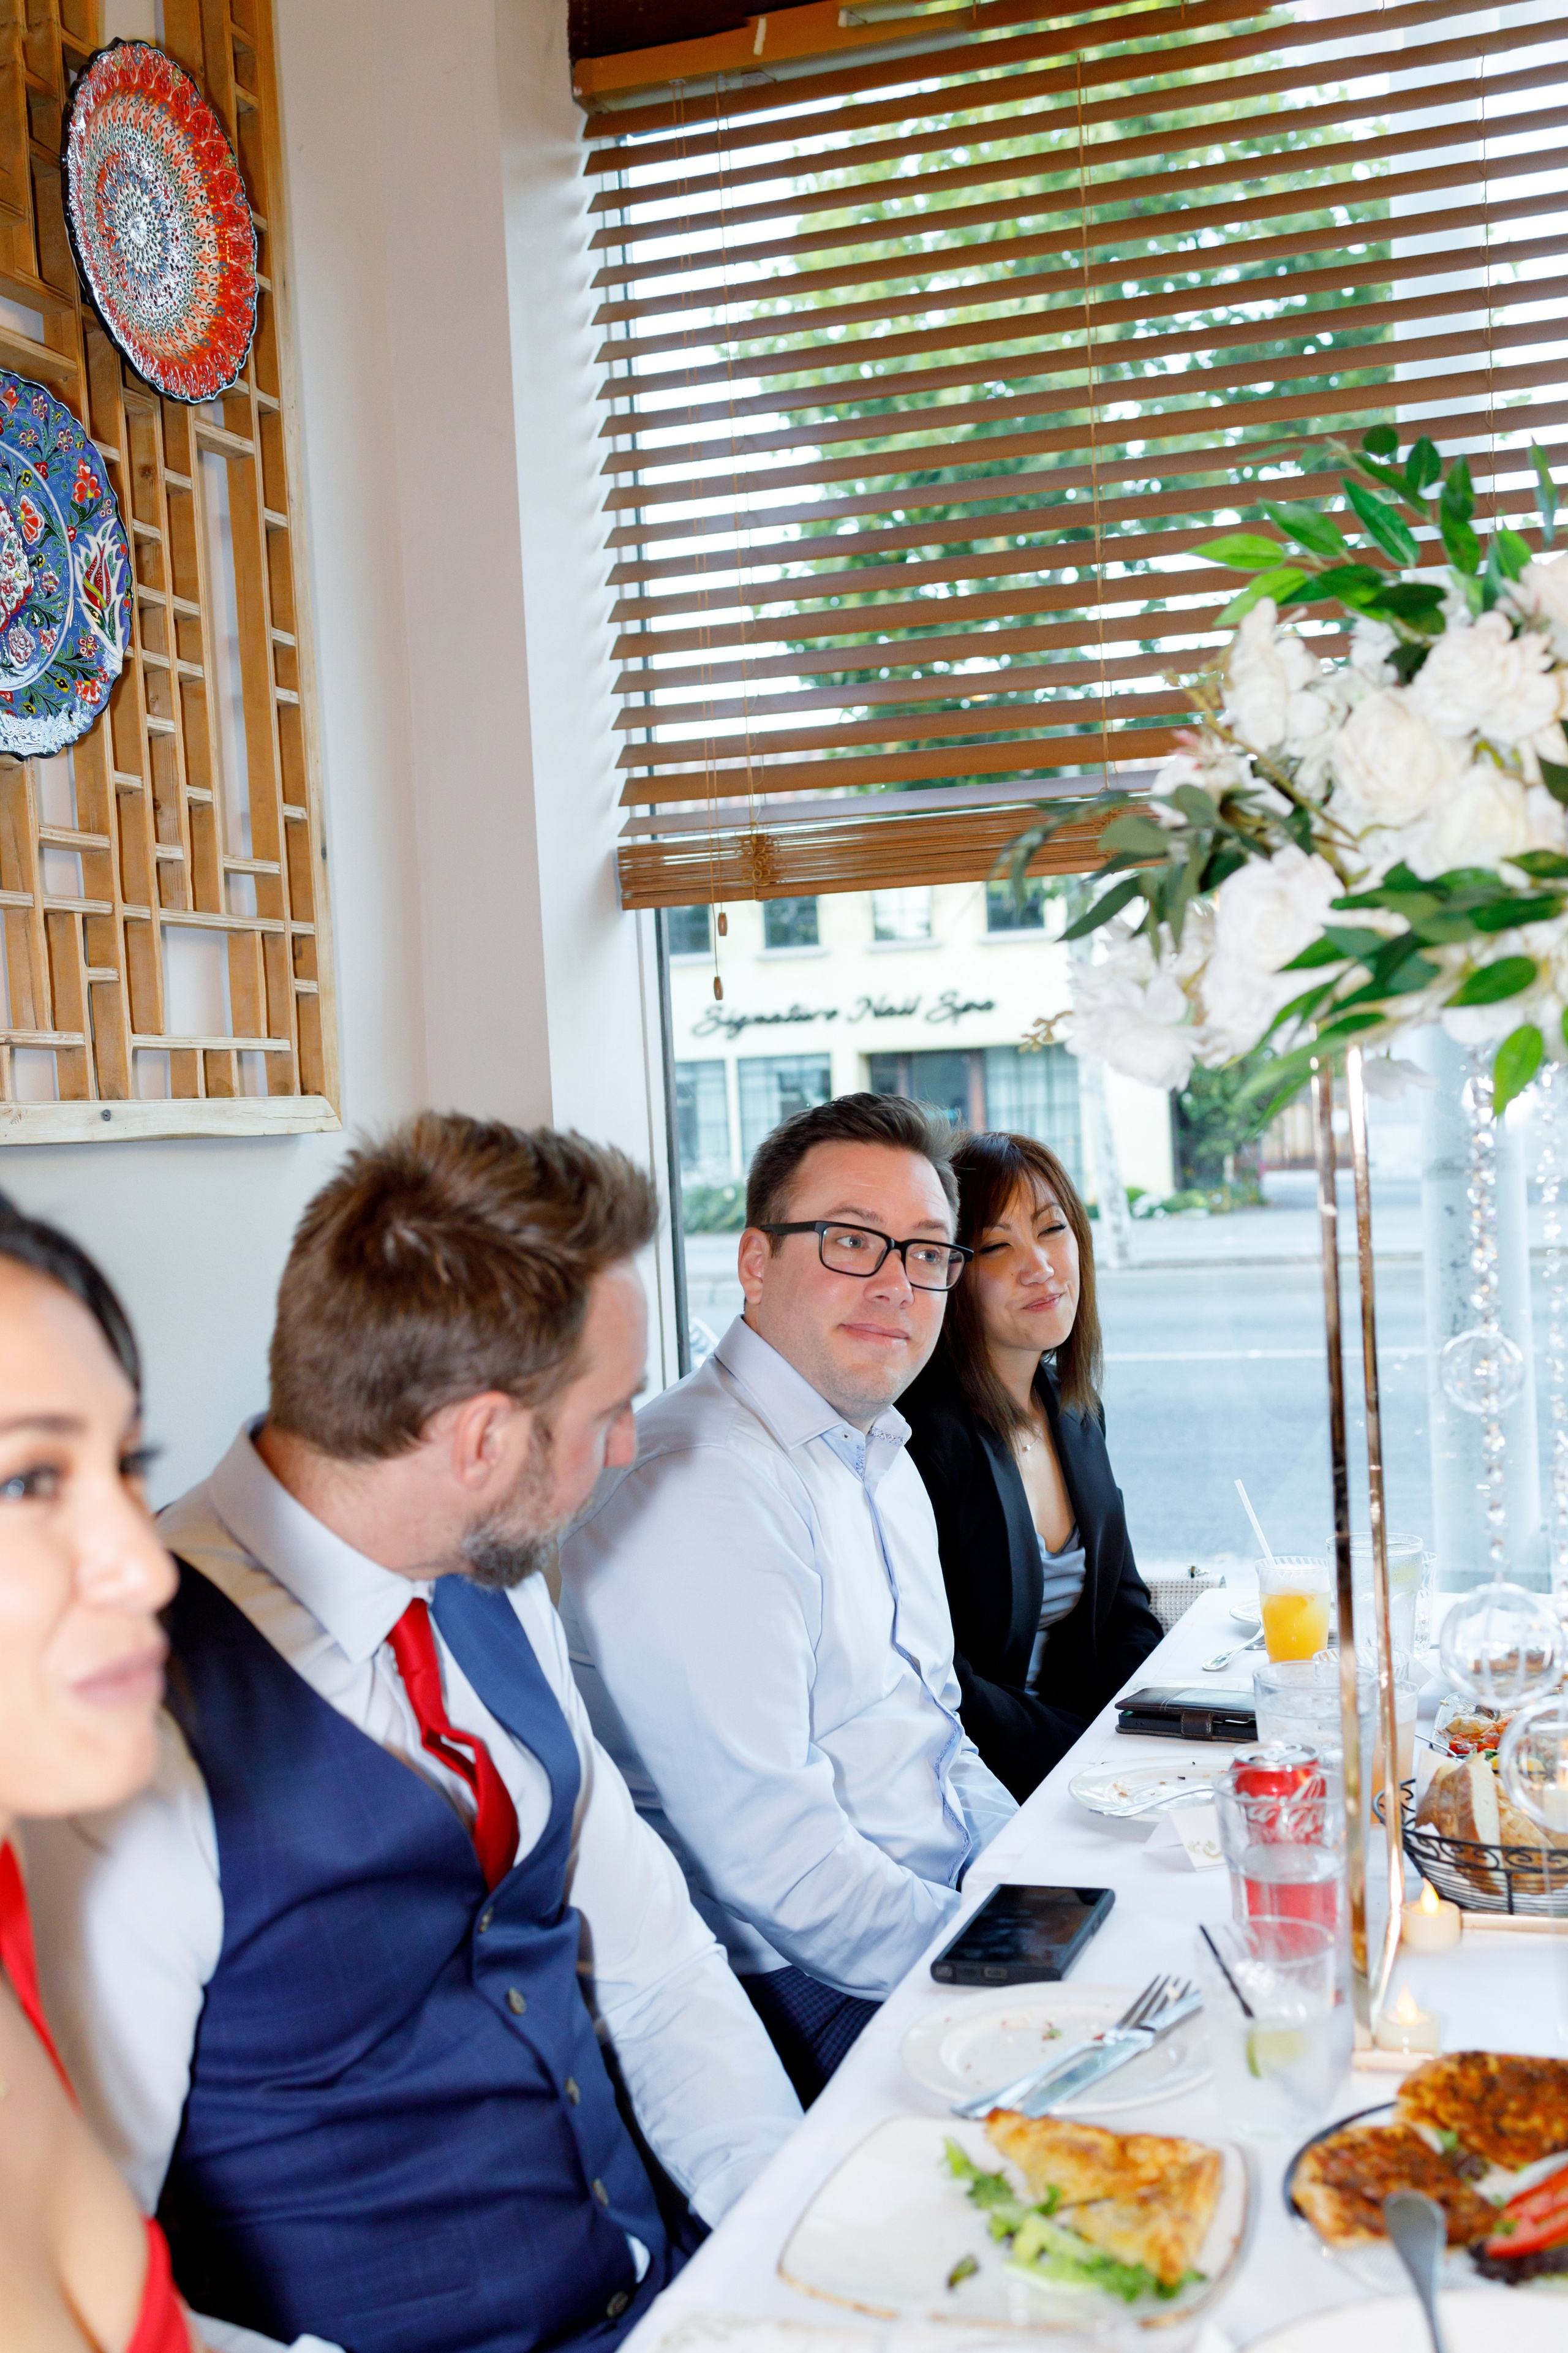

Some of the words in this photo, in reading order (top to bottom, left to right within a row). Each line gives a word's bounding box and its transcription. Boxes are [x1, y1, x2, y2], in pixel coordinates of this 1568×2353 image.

[692, 1003, 839, 1040] Signature
[846, 993, 923, 1023] Nail
[925, 989, 995, 1026] Spa
